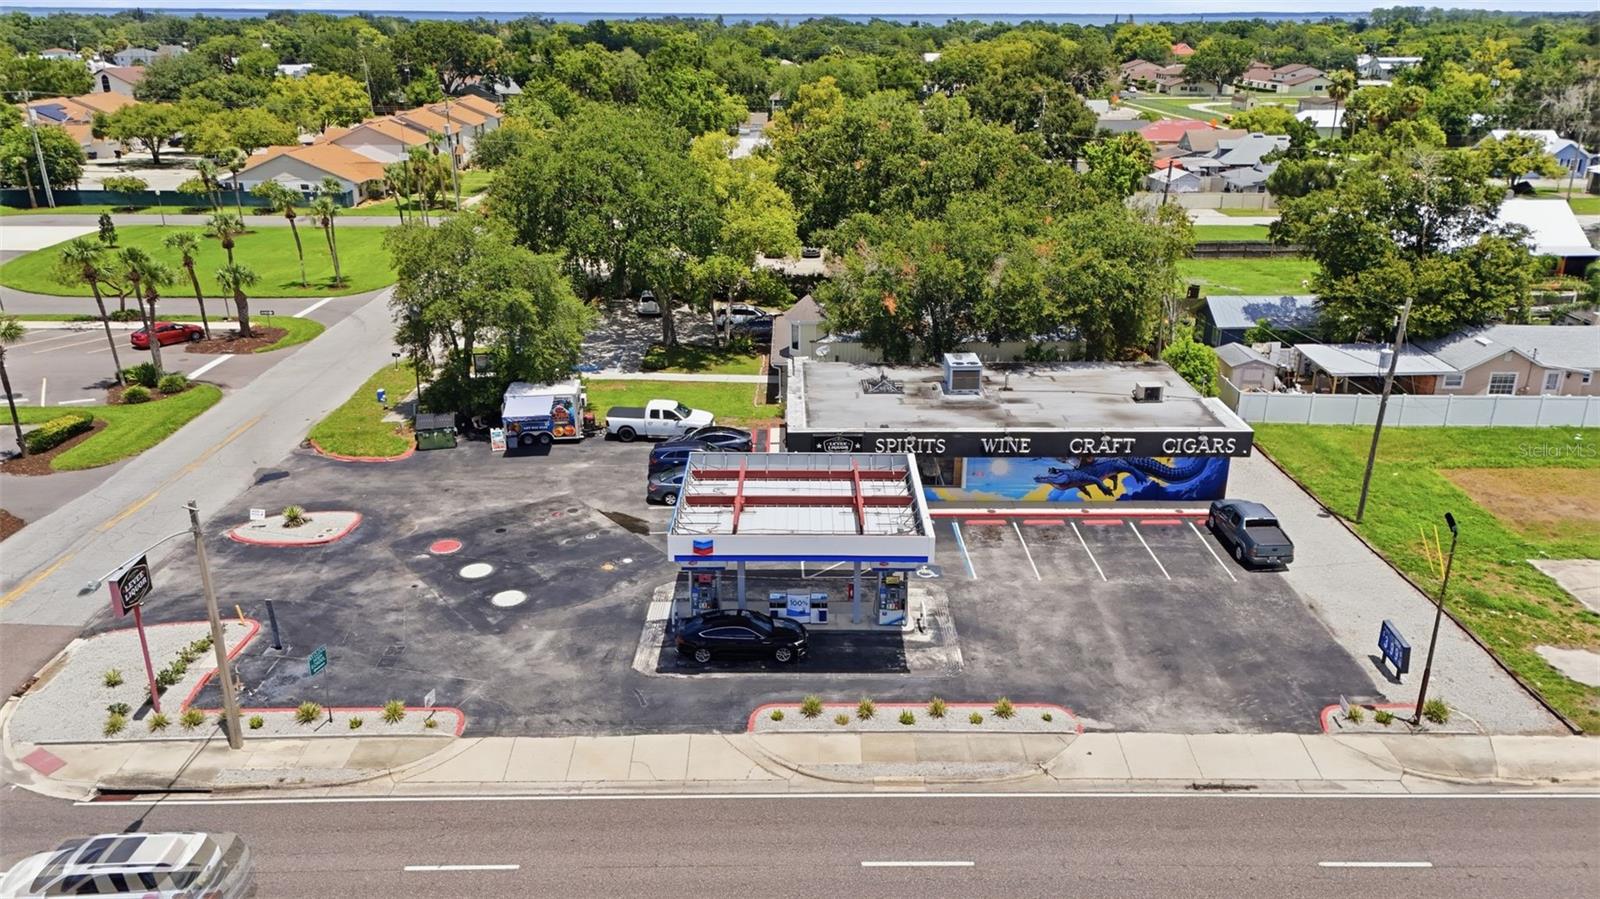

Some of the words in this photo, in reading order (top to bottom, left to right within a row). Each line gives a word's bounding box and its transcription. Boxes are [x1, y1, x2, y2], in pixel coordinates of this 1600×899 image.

[875, 438, 946, 454] SPIRITS
[981, 438, 1031, 453] WINE
[1069, 438, 1136, 454] CRAFT
[1162, 438, 1237, 454] CIGARS
[124, 570, 145, 592] LEVEE
[124, 576, 147, 602] LIQUOR
[790, 599, 808, 607] 100%
